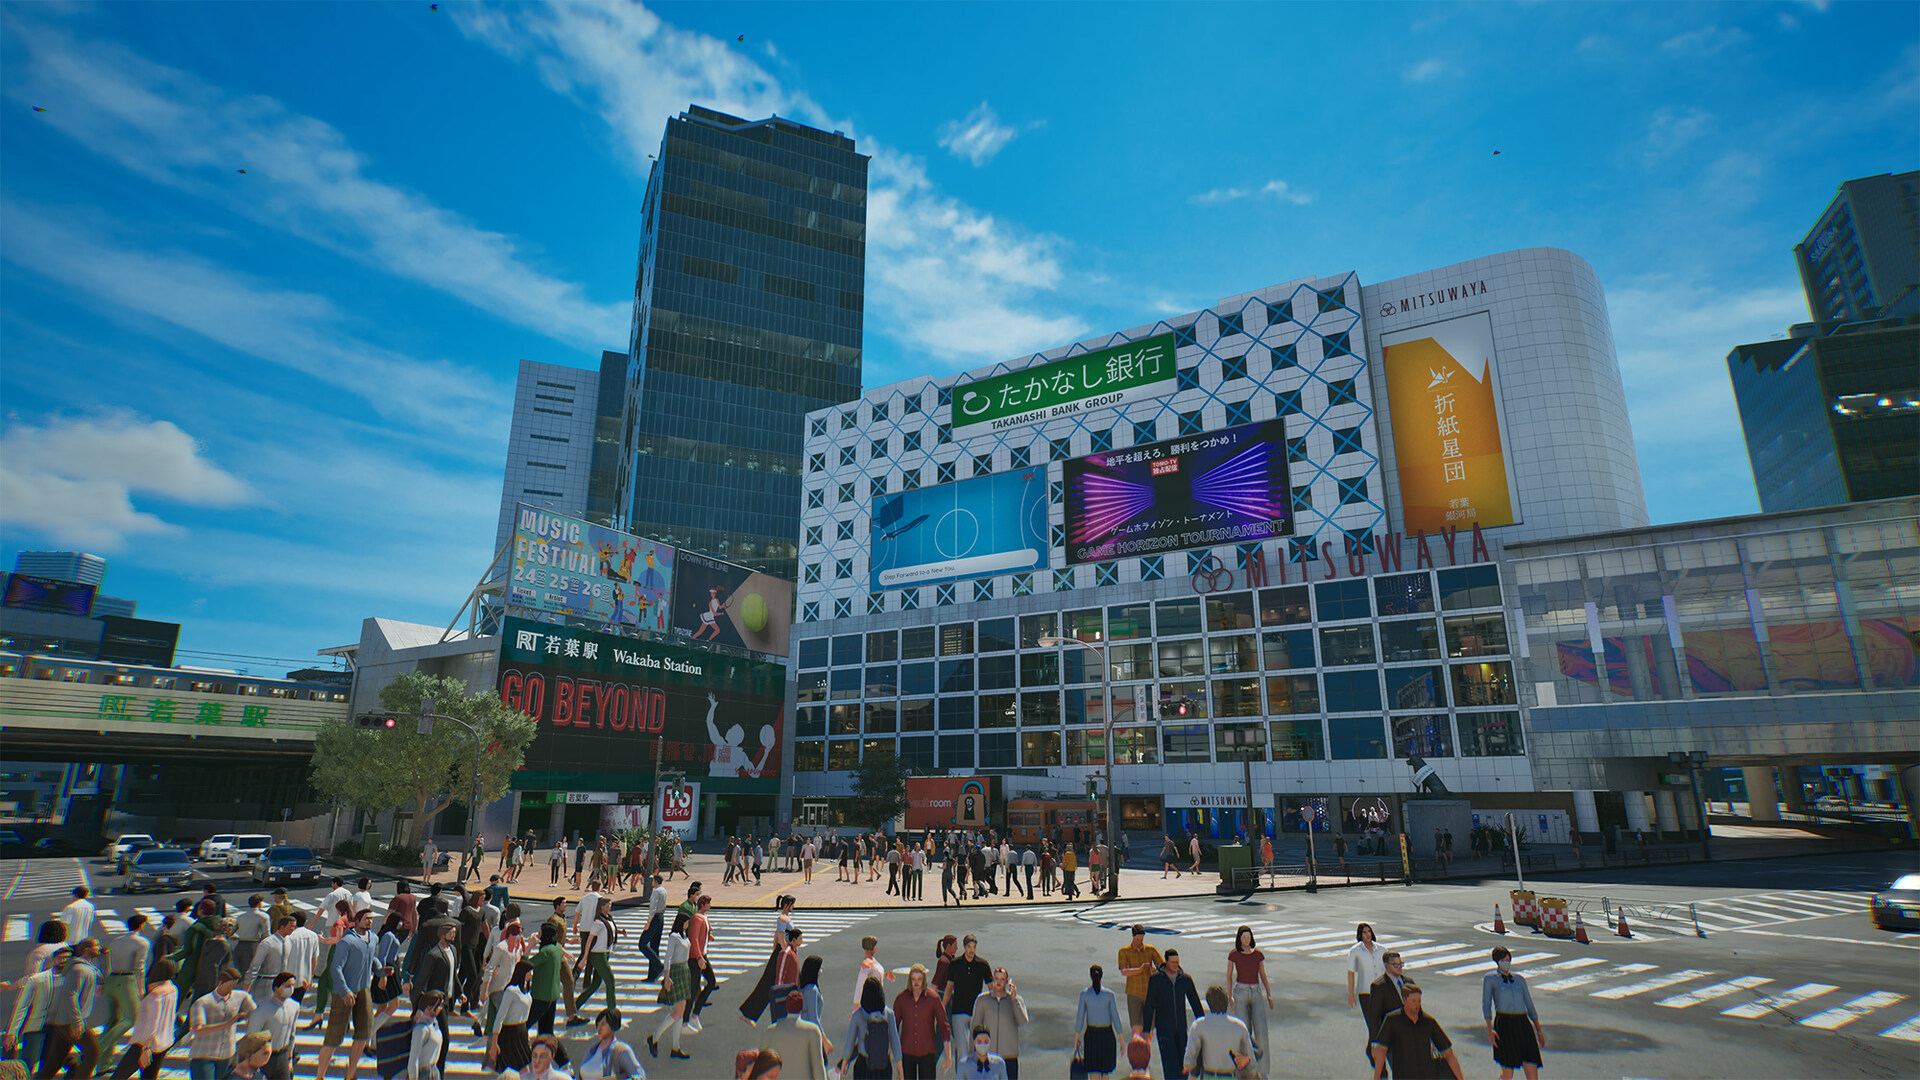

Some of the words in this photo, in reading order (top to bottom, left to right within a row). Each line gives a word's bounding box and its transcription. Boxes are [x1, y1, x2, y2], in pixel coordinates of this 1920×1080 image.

[1400, 280, 1487, 313] MITSUWAYA
[998, 346, 1163, 409] たかなし銀行
[991, 410, 1047, 430] TAKANASHI
[1052, 402, 1080, 417] BANK
[1085, 393, 1124, 409] GROUP
[1434, 393, 1466, 483] 折紙星団
[519, 509, 580, 544] MUSIC
[1077, 542, 1116, 560] GAME
[1117, 532, 1179, 554] HORIZON
[1181, 519, 1285, 545] TOURNAMENT
[1111, 509, 1233, 535] ゲームホライゾン・トーナメント
[516, 538, 598, 577] FESTIVAL
[680, 552, 701, 565] DOWN
[702, 557, 714, 569] THE
[715, 561, 729, 573] LINE
[1246, 522, 1490, 588] MITSUWAYA
[514, 565, 536, 585] 24
[549, 573, 569, 591] 25
[582, 580, 601, 598] 26
[884, 572, 895, 581] Step
[896, 569, 918, 578] Forward
[931, 566, 943, 574] New
[544, 635, 599, 661] 若葉駅
[613, 648, 661, 669] Wakaba
[663, 657, 703, 676] Station
[148, 698, 270, 728] 若葉駅
[500, 669, 545, 723] GO
[552, 675, 666, 734] BEYOND
[665, 808, 690, 817] モバイル
[1201, 796, 1247, 806] MITSUWAYA
